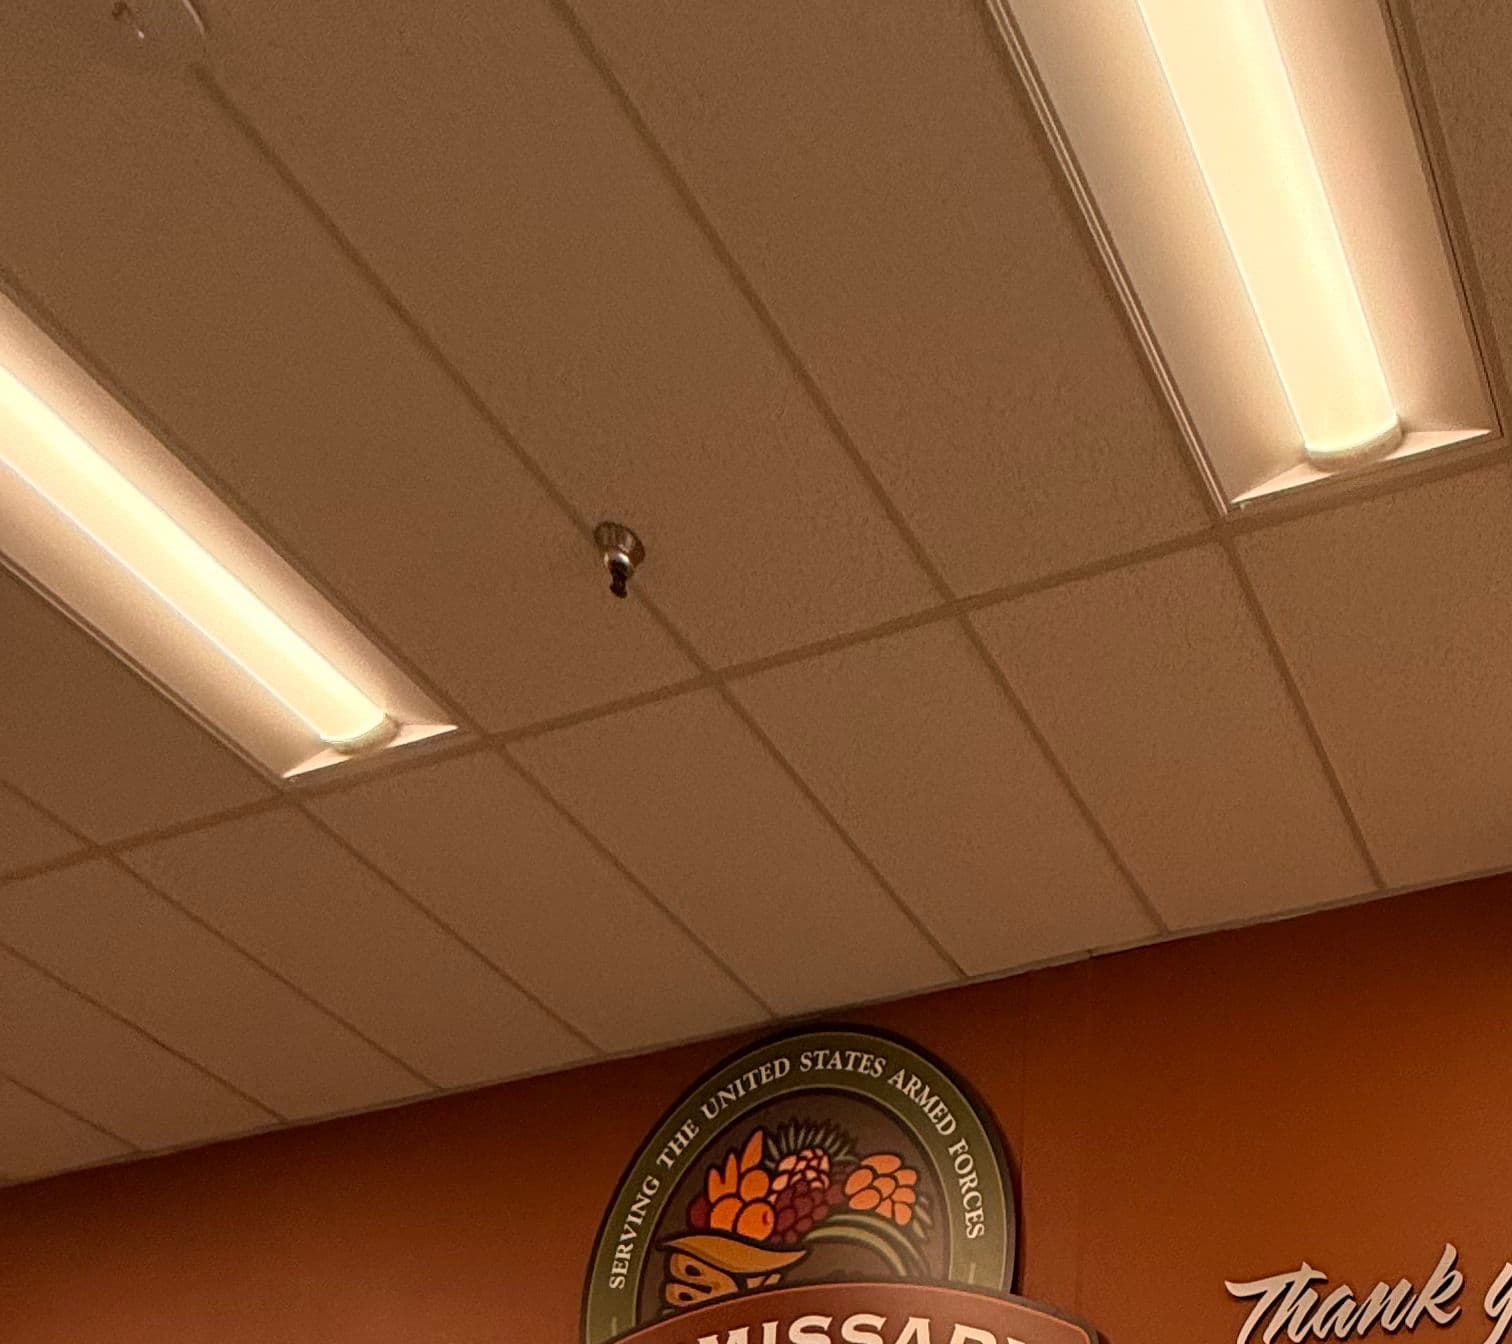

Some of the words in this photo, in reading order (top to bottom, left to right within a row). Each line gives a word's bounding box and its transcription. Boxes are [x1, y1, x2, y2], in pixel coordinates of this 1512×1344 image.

[607, 1176, 660, 1290] SERVING
[656, 1119, 700, 1170] THE
[700, 1057, 791, 1121] UNITED
[800, 1050, 886, 1079] STATES
[887, 1067, 956, 1138] ARMED
[948, 1139, 985, 1239] FORCES
